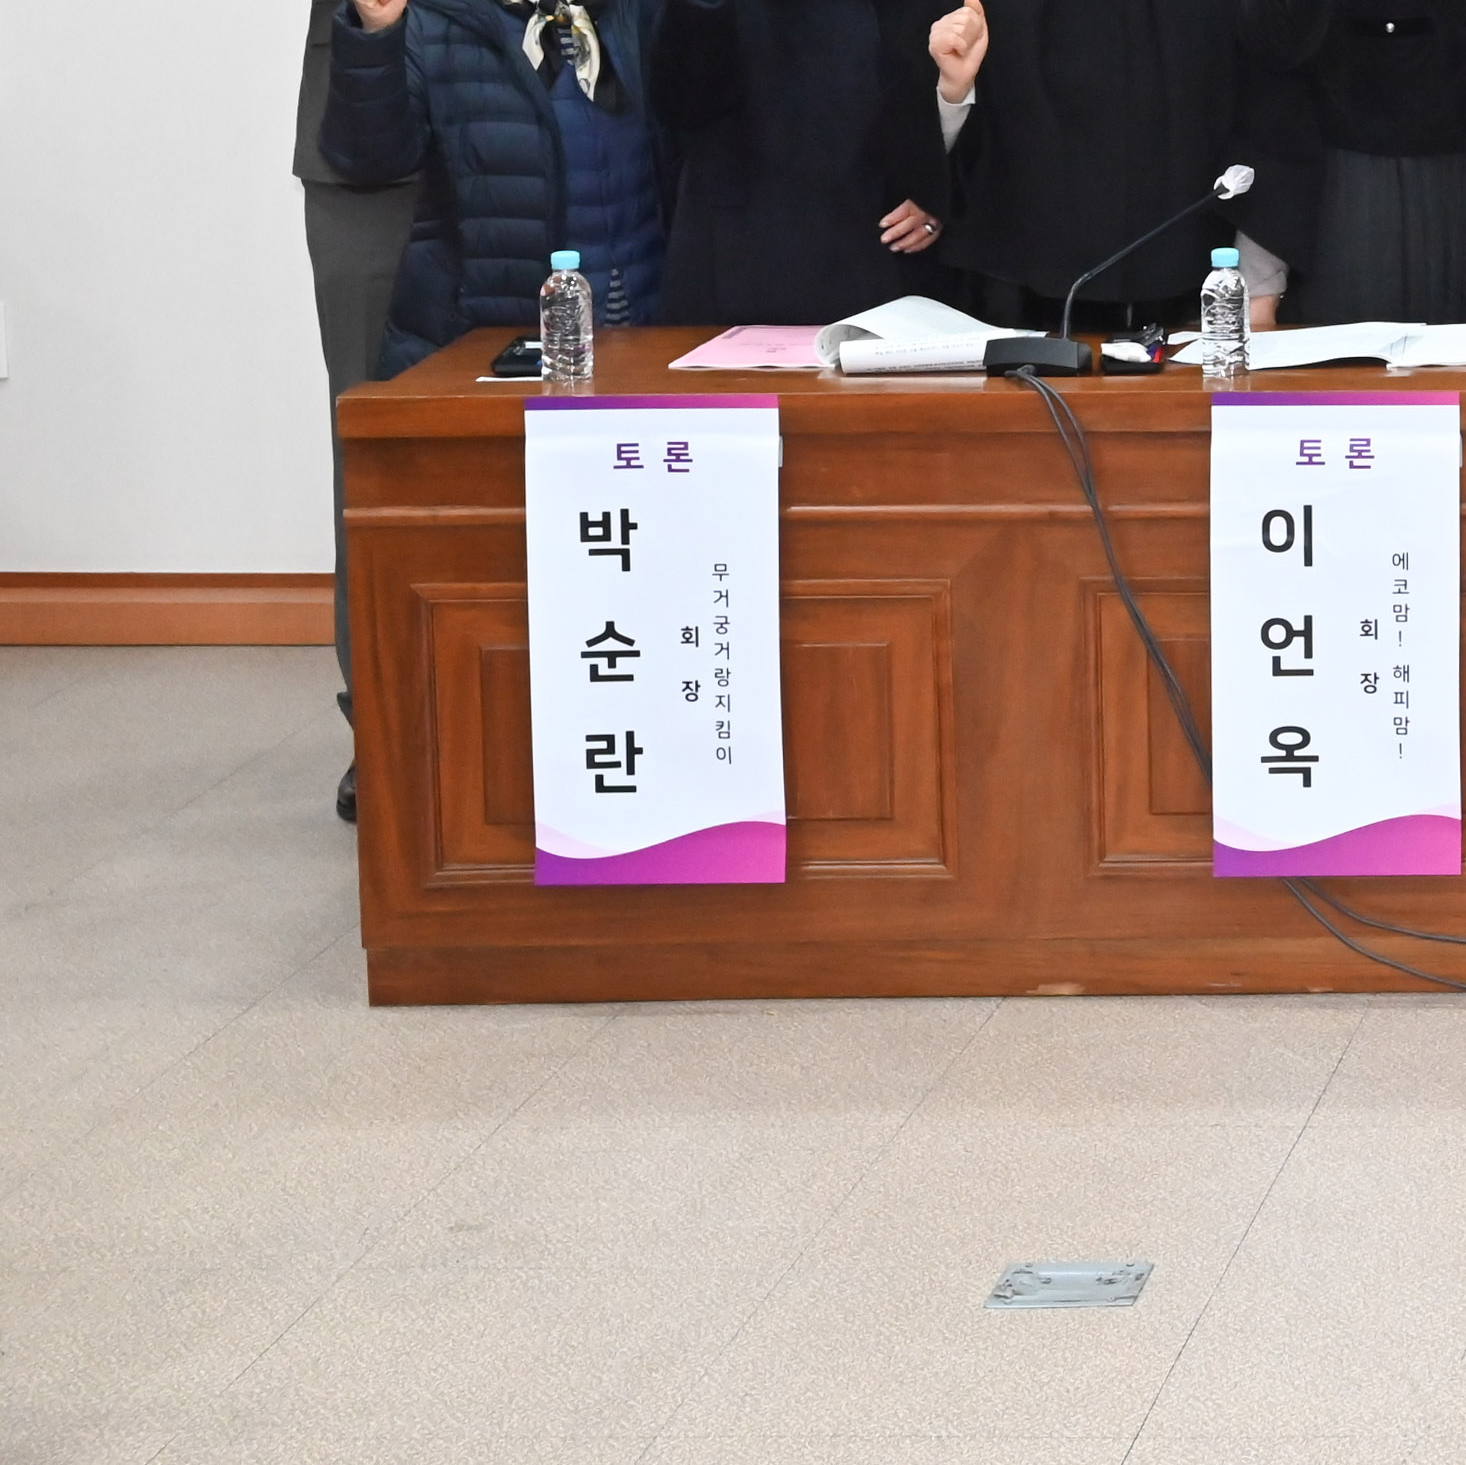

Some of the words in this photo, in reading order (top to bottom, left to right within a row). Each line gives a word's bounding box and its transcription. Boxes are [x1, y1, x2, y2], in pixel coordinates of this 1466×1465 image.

[1392, 551, 1410, 647] 에코맘!
[712, 563, 732, 765] 무거궁거랑지킴이
[1392, 664, 1410, 760] 해피맘!
